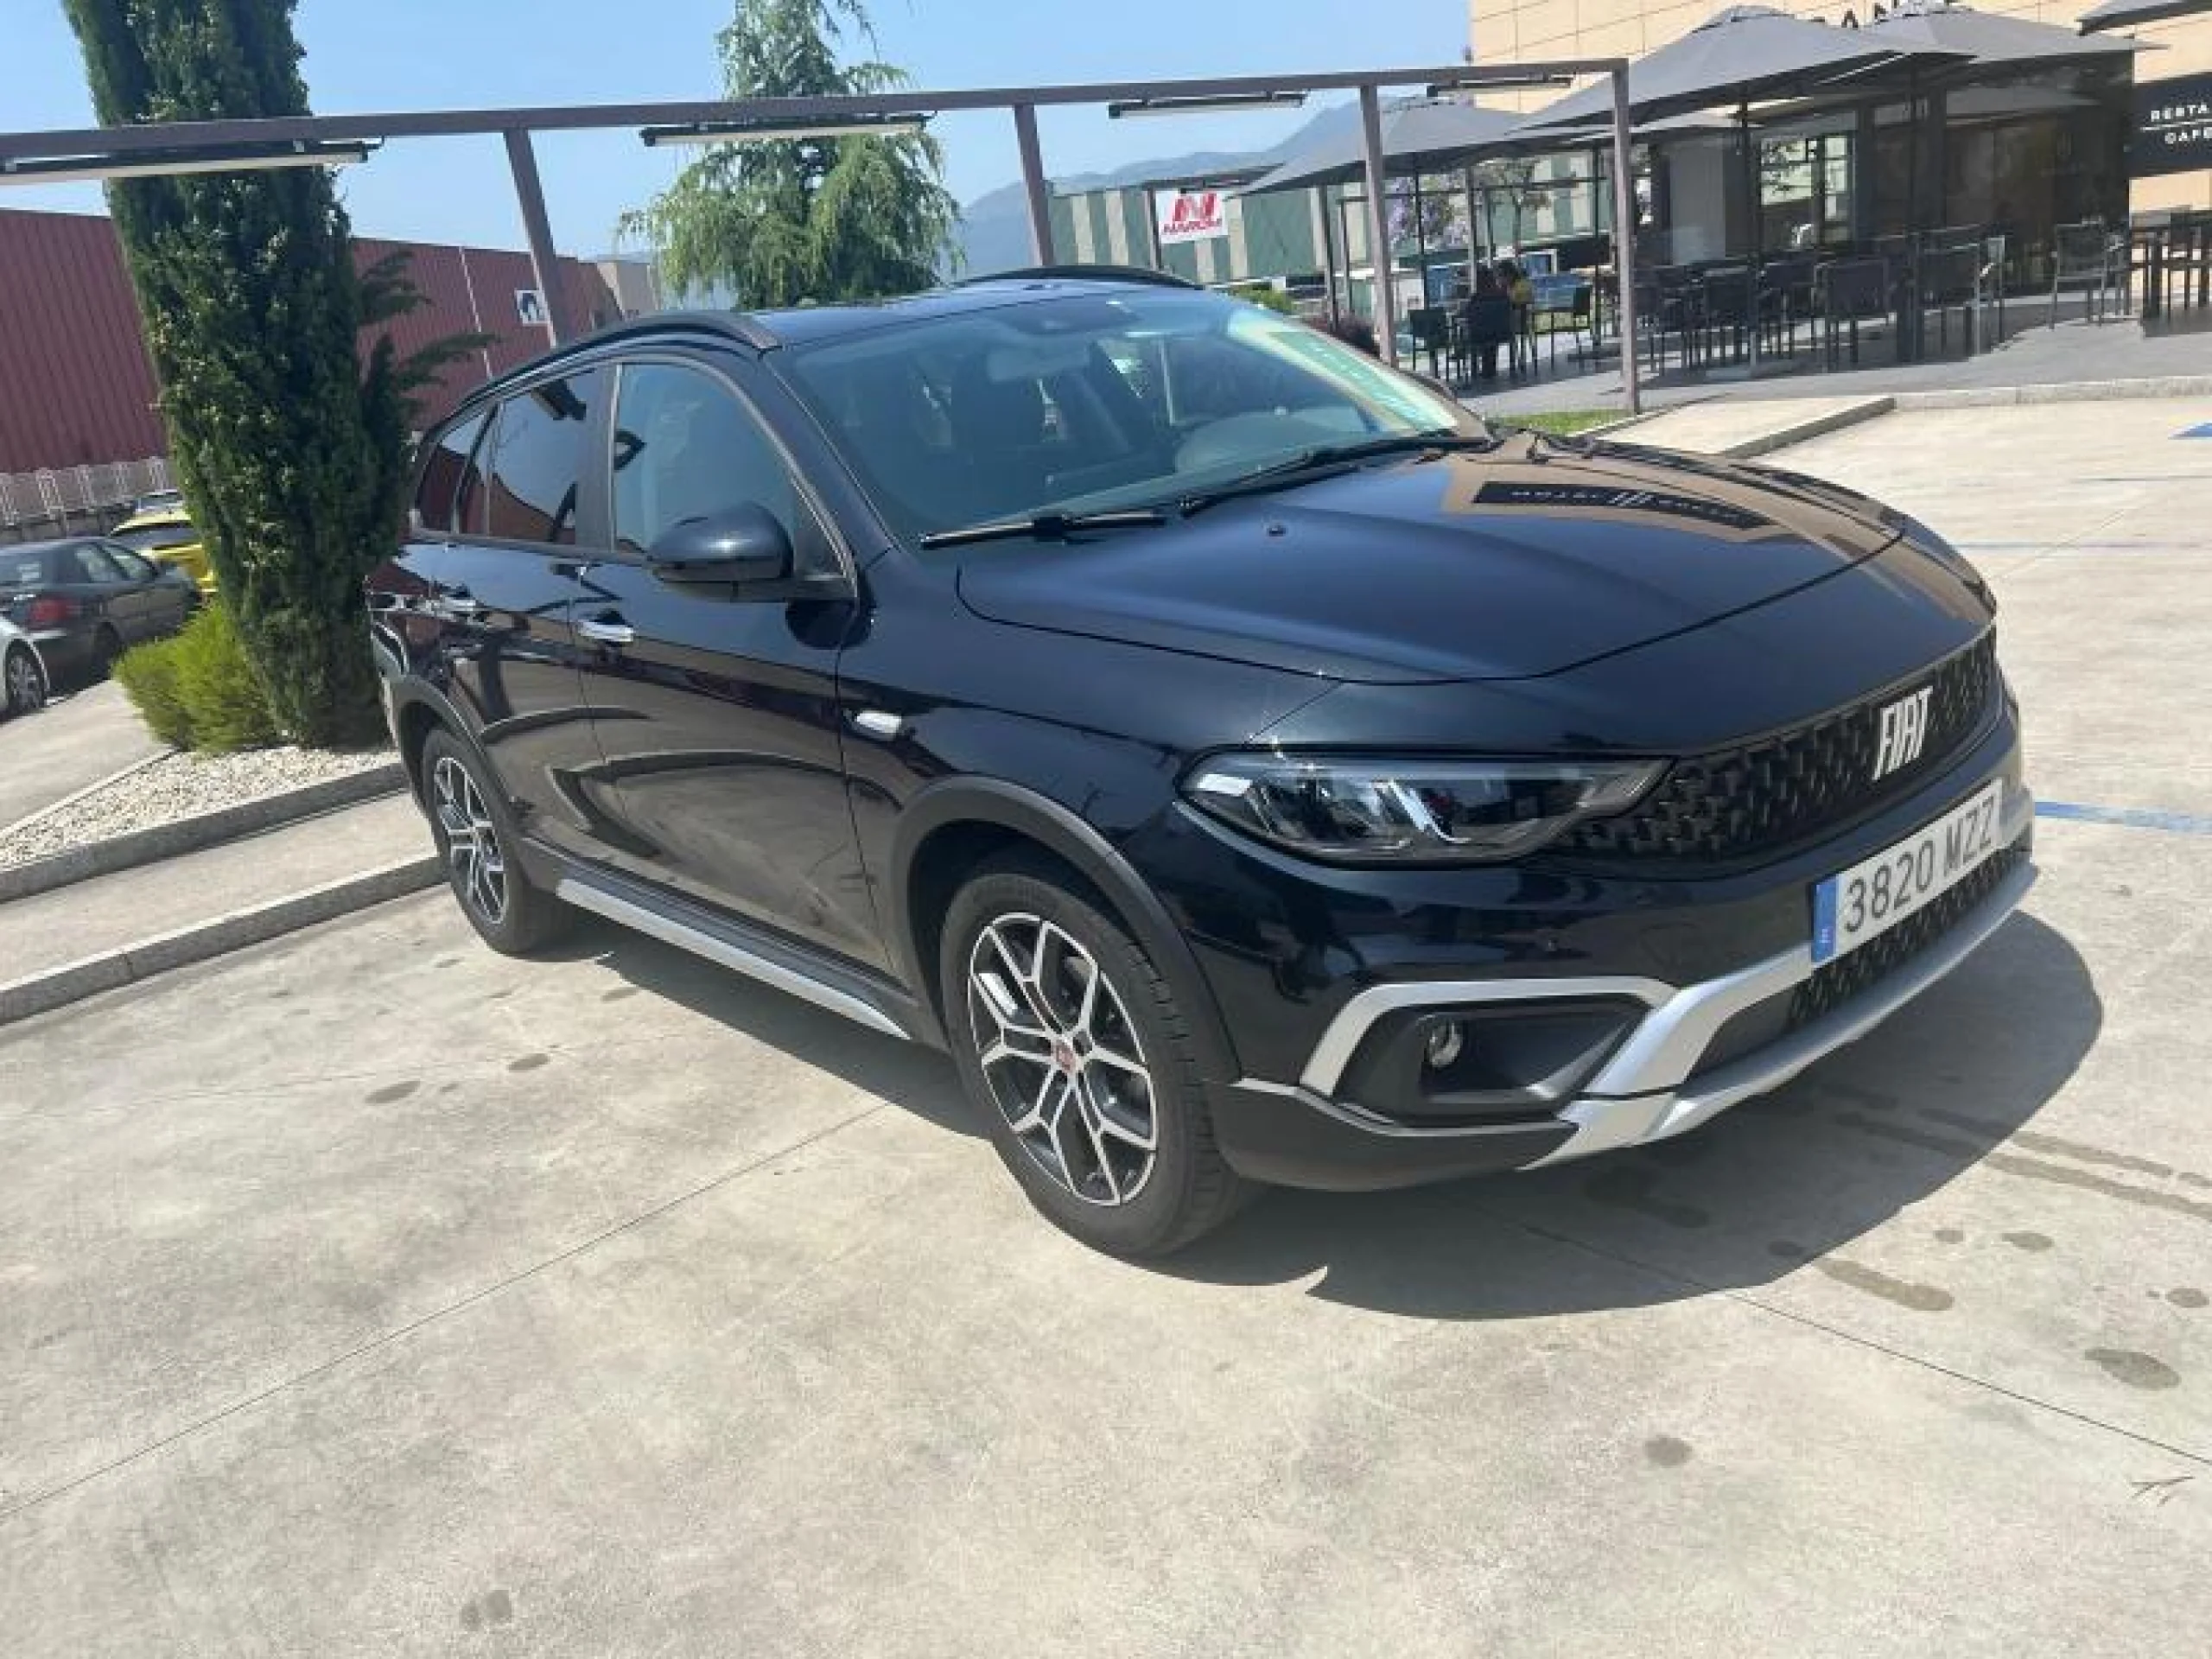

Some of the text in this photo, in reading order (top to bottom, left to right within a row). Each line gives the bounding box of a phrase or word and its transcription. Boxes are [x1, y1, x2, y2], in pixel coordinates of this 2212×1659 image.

[1871, 685, 1934, 781] FIAT
[1843, 795, 1995, 933] 3820 MZZ
